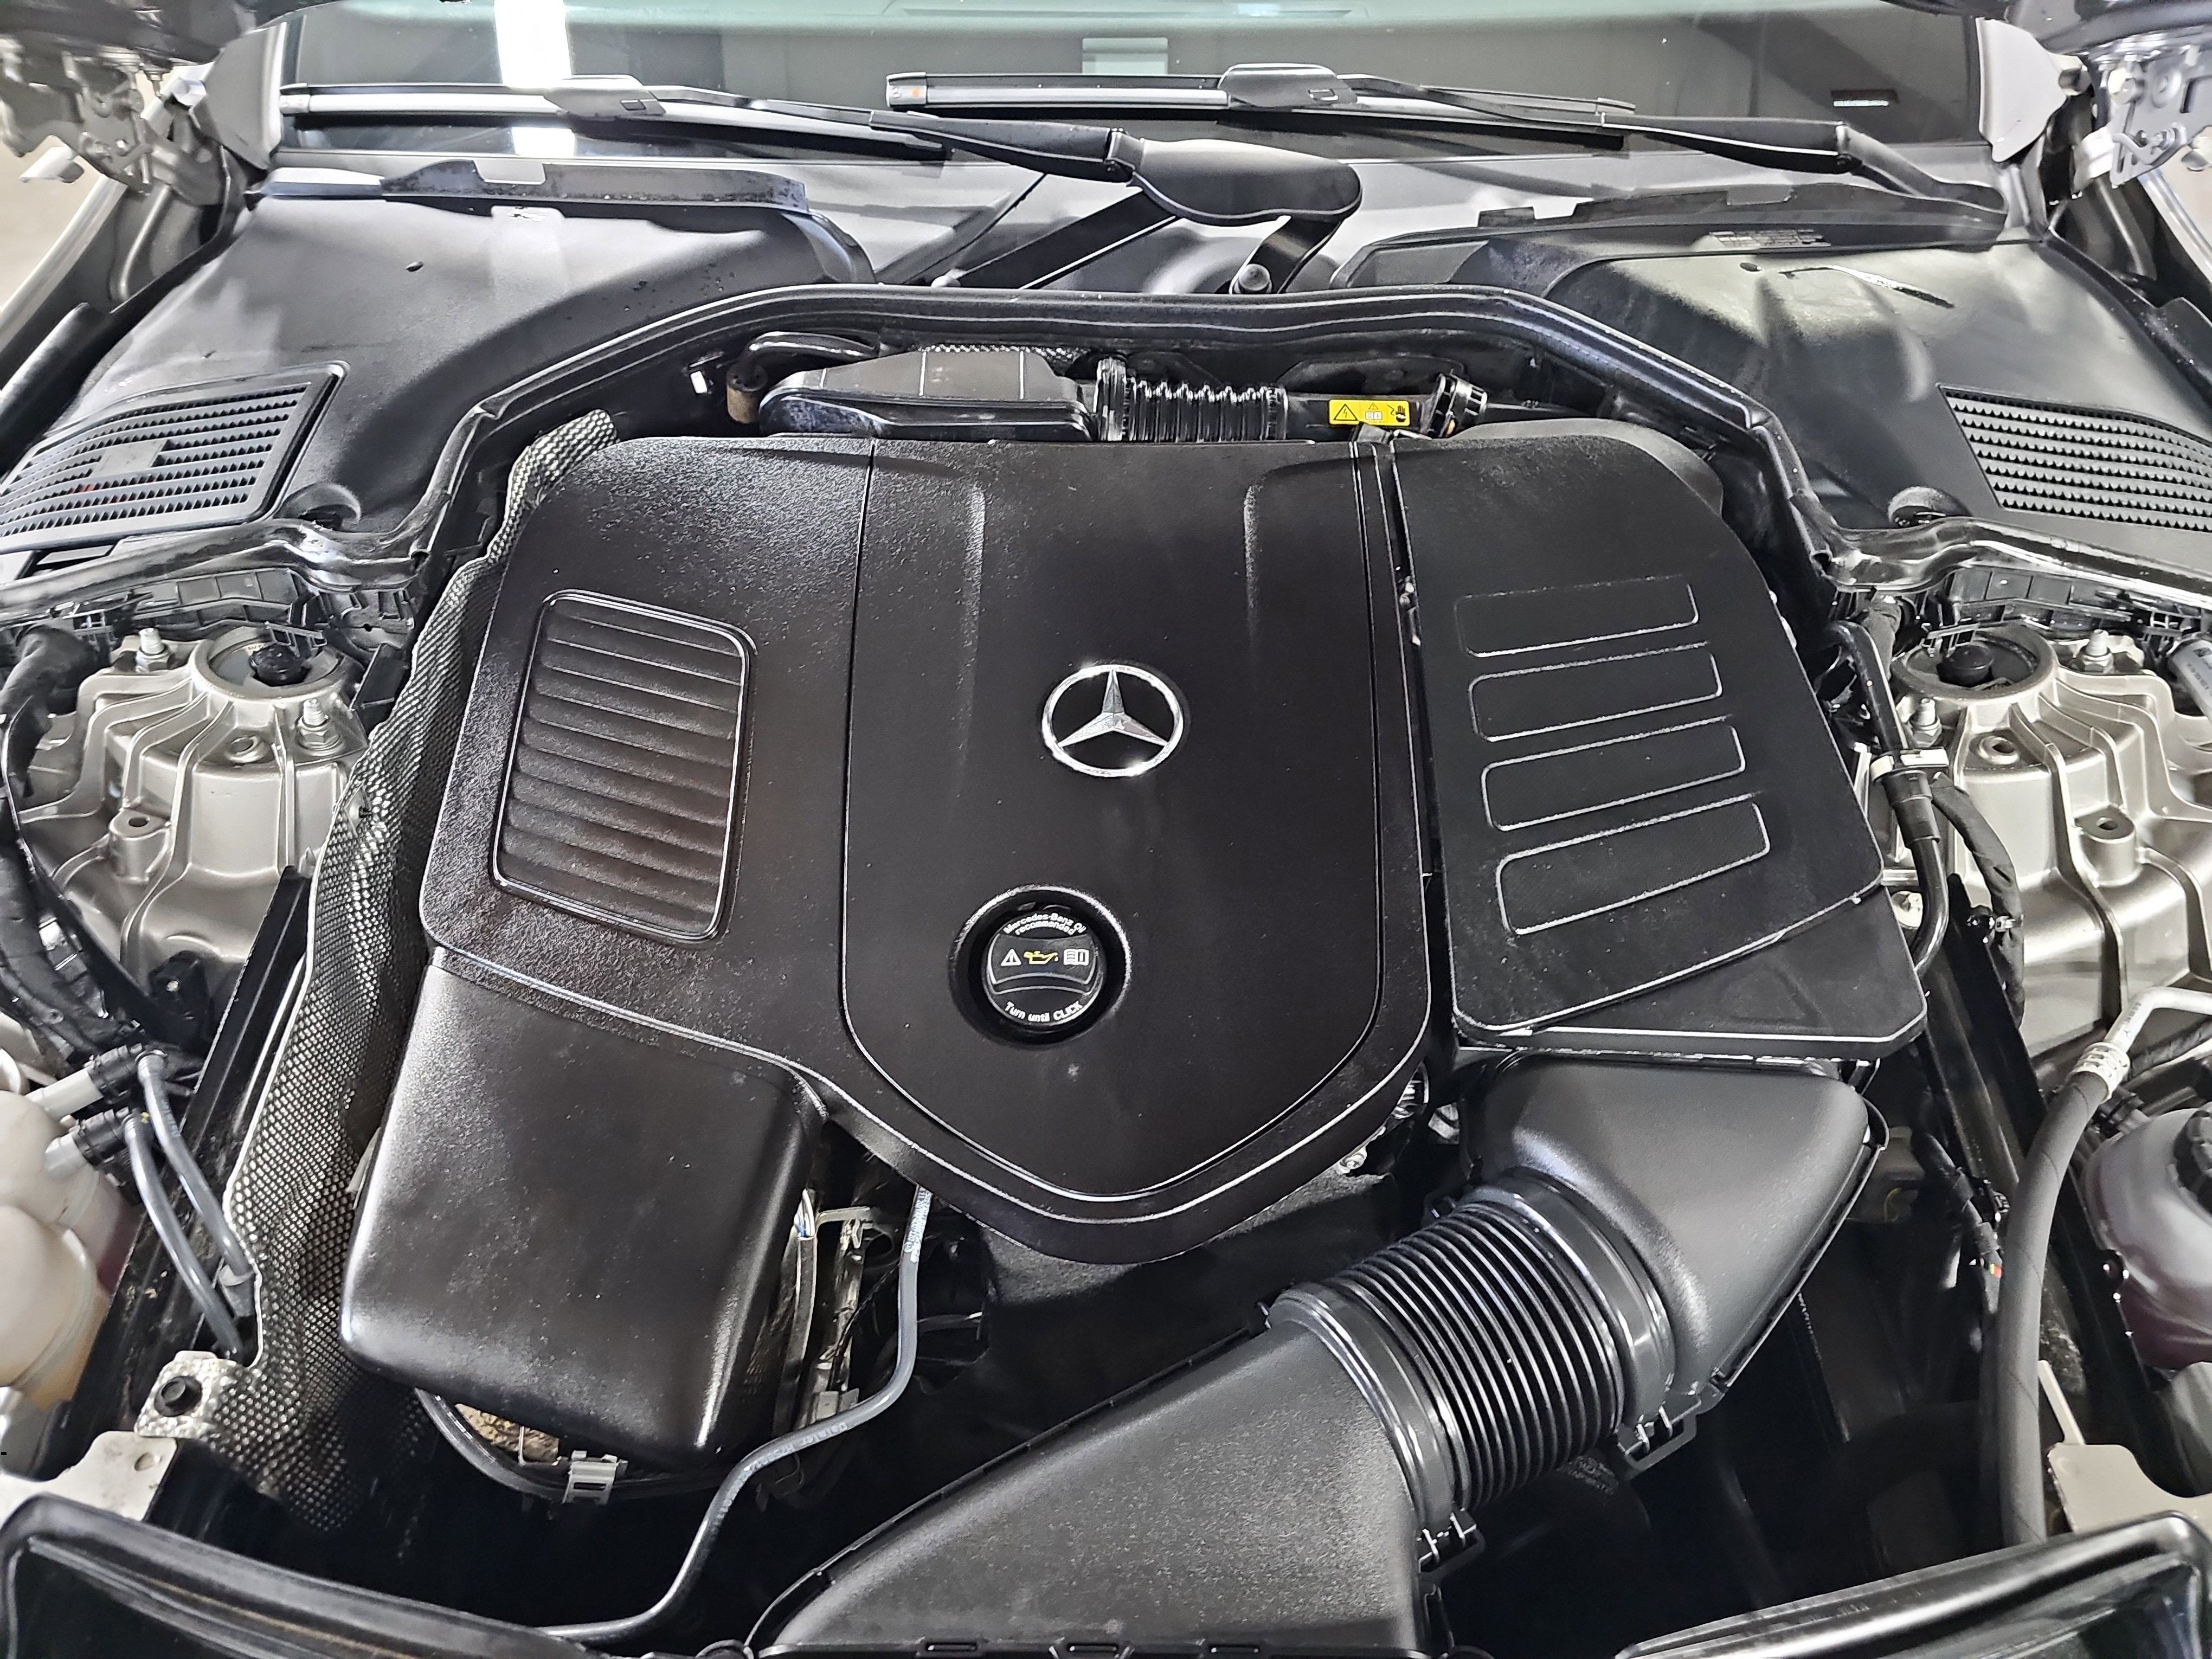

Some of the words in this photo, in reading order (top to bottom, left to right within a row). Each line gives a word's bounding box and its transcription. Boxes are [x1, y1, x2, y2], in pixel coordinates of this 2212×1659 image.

[1003, 913, 1074, 934] Mercedes-Benz
[1073, 923, 1086, 934] Oil
[1015, 921, 1076, 935] recommended
[1005, 1001, 1026, 1019] Turn
[1028, 1012, 1050, 1022] until
[1053, 1000, 1083, 1020] CLICK
